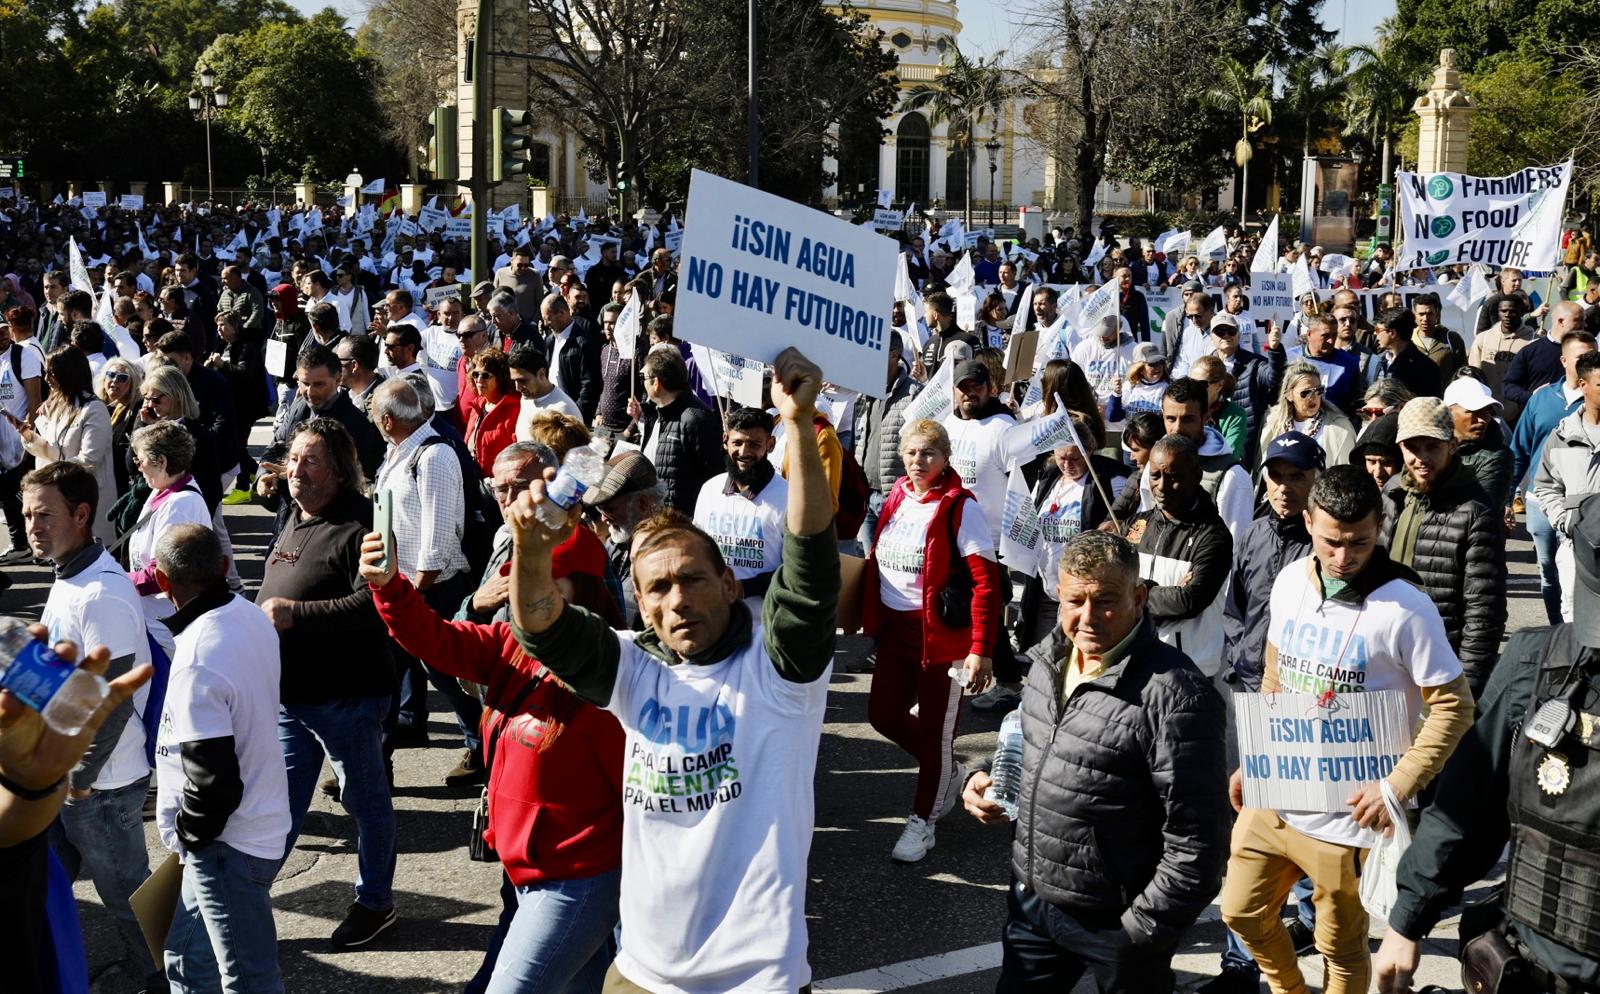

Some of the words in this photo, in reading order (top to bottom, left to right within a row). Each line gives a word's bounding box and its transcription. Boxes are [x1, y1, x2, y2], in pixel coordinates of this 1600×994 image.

[1461, 166, 1563, 198] FARMERS
[796, 237, 855, 288] AGUA
[1456, 239, 1533, 268] FUTURE
[687, 256, 723, 299] NO
[731, 269, 780, 315] HAY
[784, 286, 884, 350] FUTURO!!
[1253, 296, 1262, 306] NO
[1263, 296, 1275, 307] HAY
[708, 512, 764, 540] AGUA
[1054, 518, 1080, 528] CAMPO
[724, 536, 734, 545] EL
[735, 537, 765, 549] CAMPO
[733, 558, 764, 569] MUNDO
[892, 562, 902, 572] EL
[1281, 619, 1368, 672] AGUA
[1278, 652, 1298, 669] PARA
[1299, 659, 1313, 675] EL
[1316, 663, 1366, 684] CAMPO
[637, 697, 736, 755] AGUA
[1269, 717, 1315, 744] ¡¡SIN
[1320, 715, 1374, 744] AGUA
[658, 756, 679, 774] EL
[1245, 754, 1271, 780] NO
[1276, 755, 1312, 781] HAY
[659, 797, 683, 813] EL
